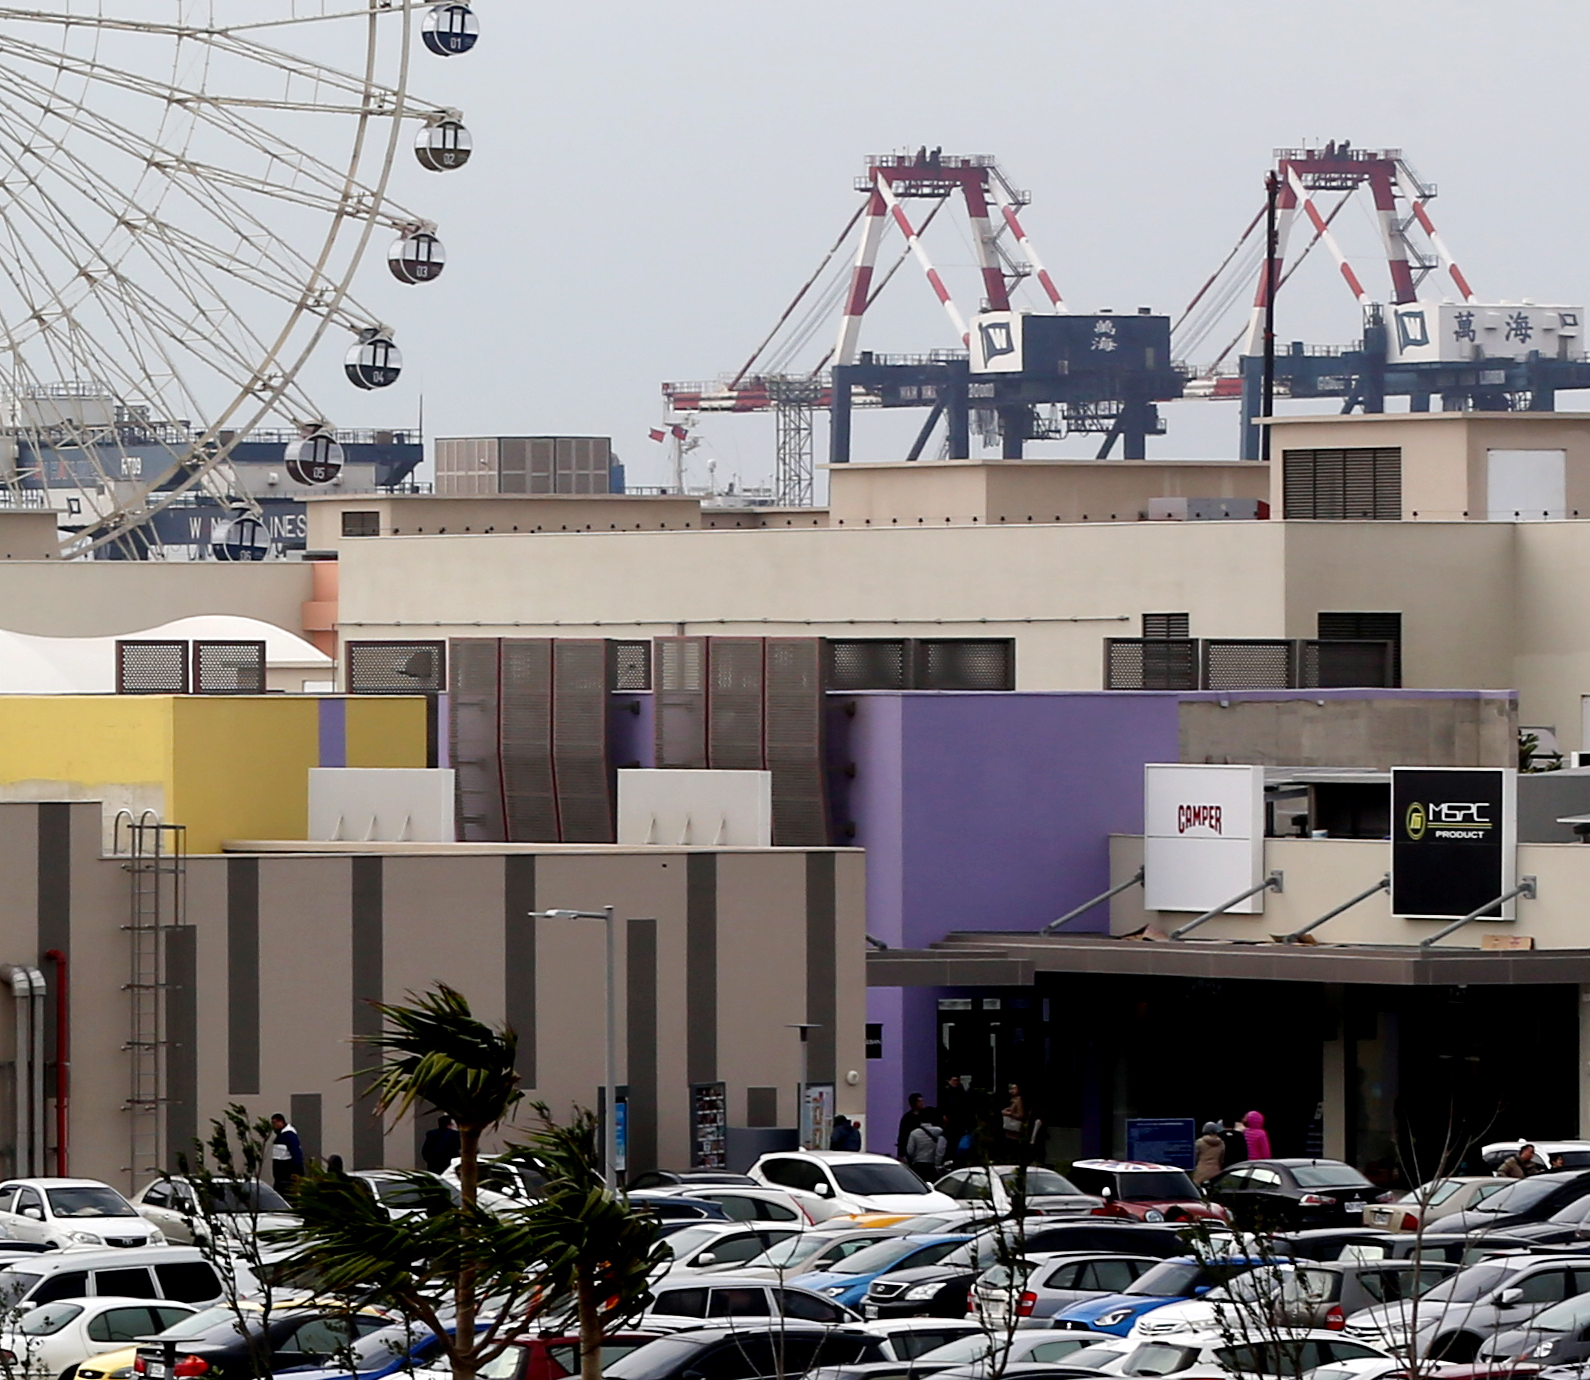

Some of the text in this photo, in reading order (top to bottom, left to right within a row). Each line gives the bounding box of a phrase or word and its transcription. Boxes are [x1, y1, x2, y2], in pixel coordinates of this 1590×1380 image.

[450, 37, 461, 48] 01
[444, 154, 455, 165] 02
[417, 266, 427, 277] 03
[1453, 311, 1534, 343] 萬海
[373, 372, 384, 383] 04
[314, 467, 325, 478] 05
[1429, 803, 1490, 821] MSPC
[1178, 804, 1222, 834] CAMPER
[1435, 830, 1484, 839] PRODUCT
